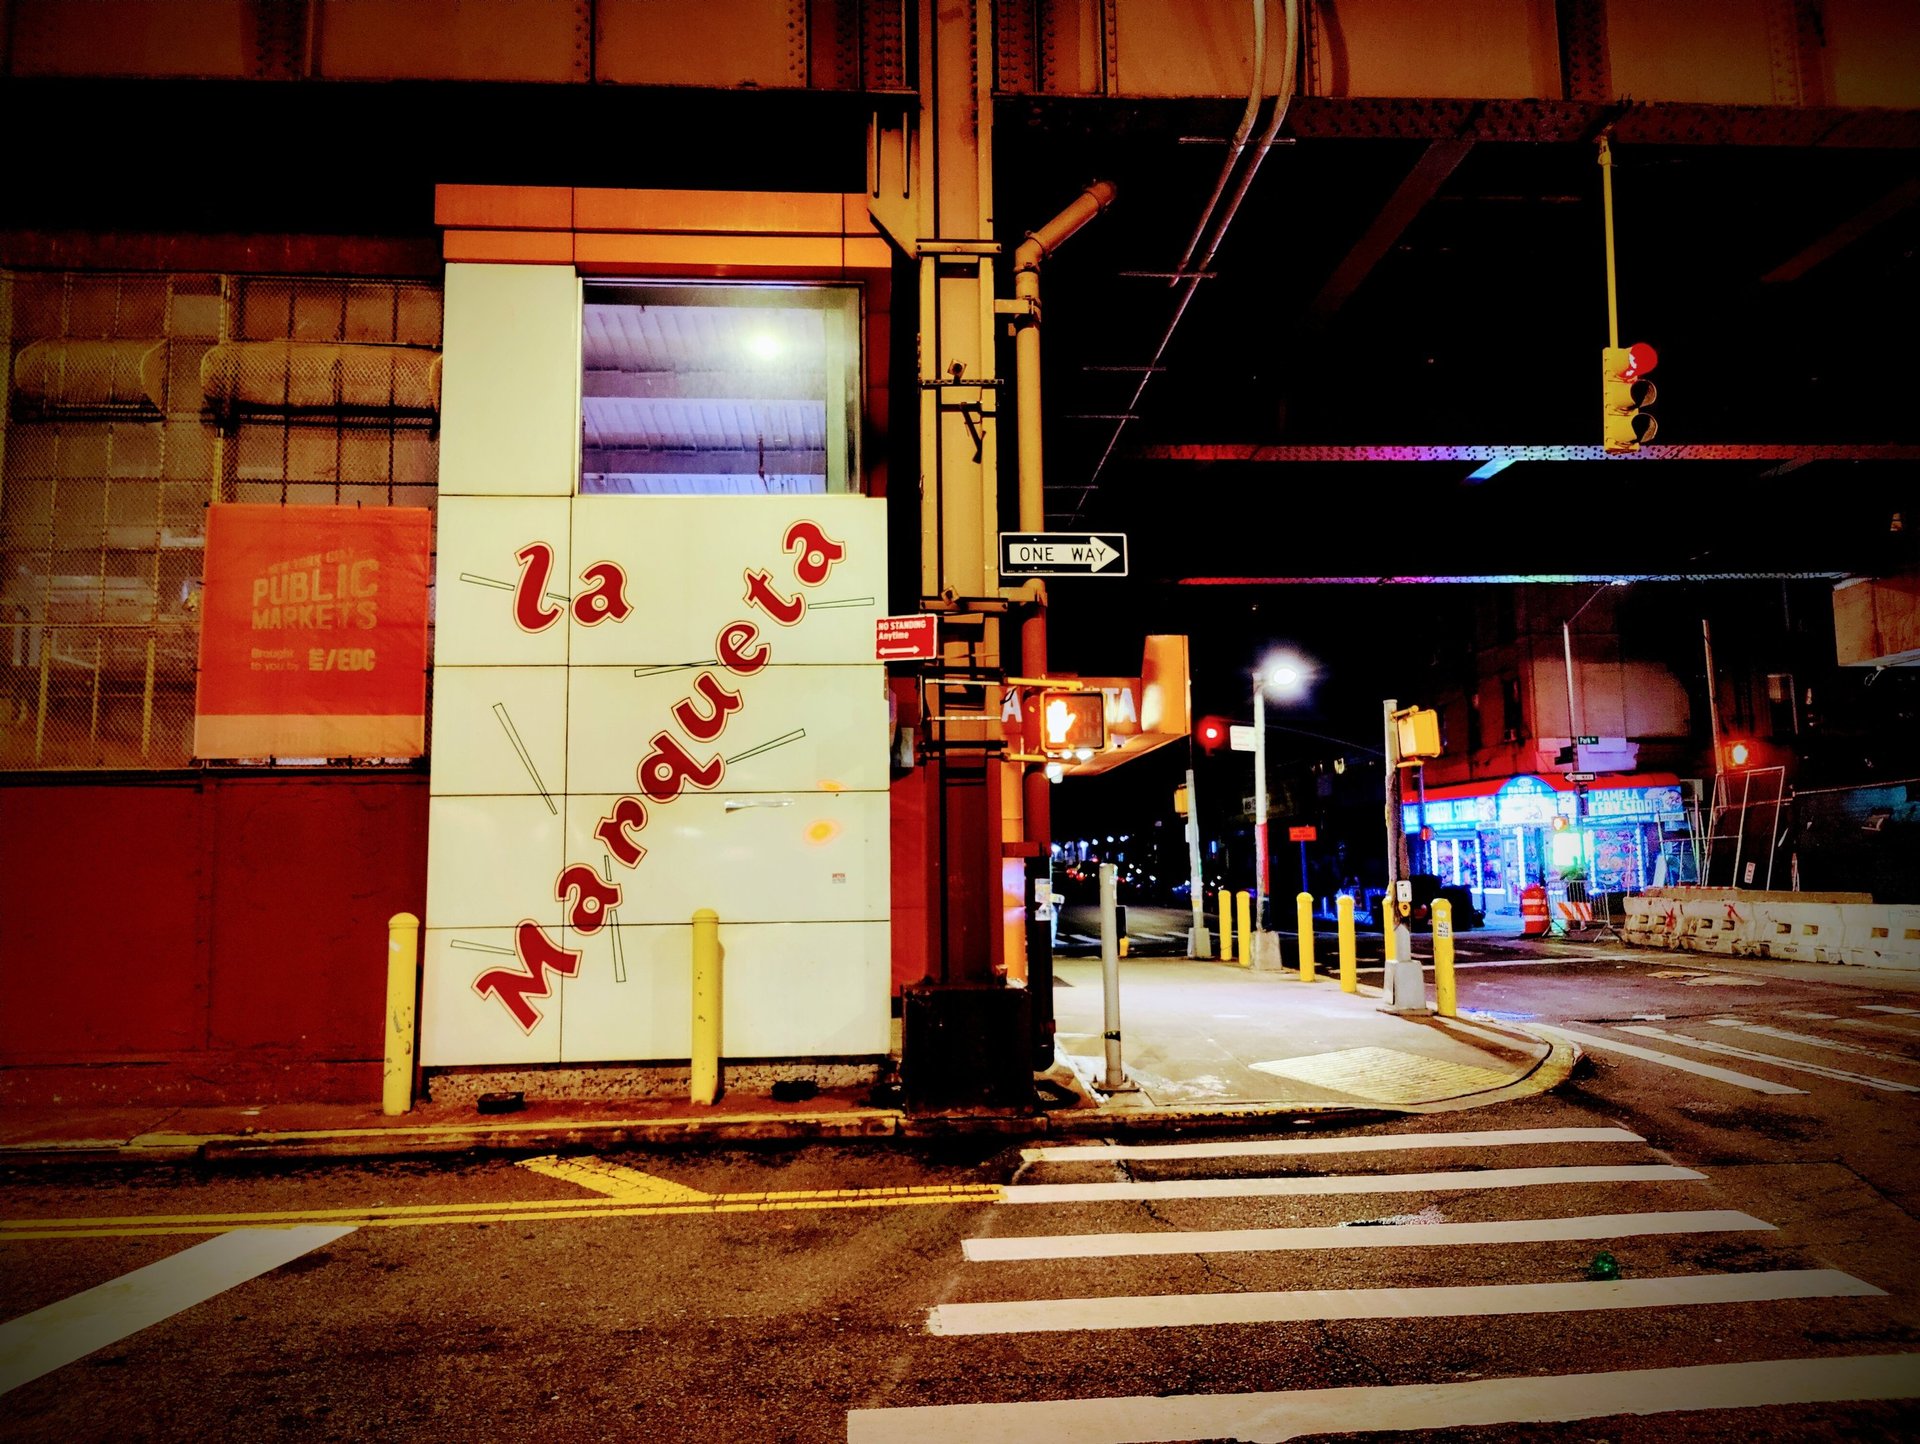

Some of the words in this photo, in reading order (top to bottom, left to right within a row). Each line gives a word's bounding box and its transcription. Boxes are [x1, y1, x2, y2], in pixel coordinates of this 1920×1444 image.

[1020, 547, 1054, 562] ONE
[1071, 547, 1106, 562] WAY
[252, 558, 380, 608] PUBLIC
[251, 600, 378, 630] MARKETS
[878, 622, 889, 631] NO
[890, 620, 926, 630] STANDING
[879, 631, 909, 641] Anytime
[471, 519, 847, 1036] Marqueta
[1595, 788, 1639, 802] PAMELA
